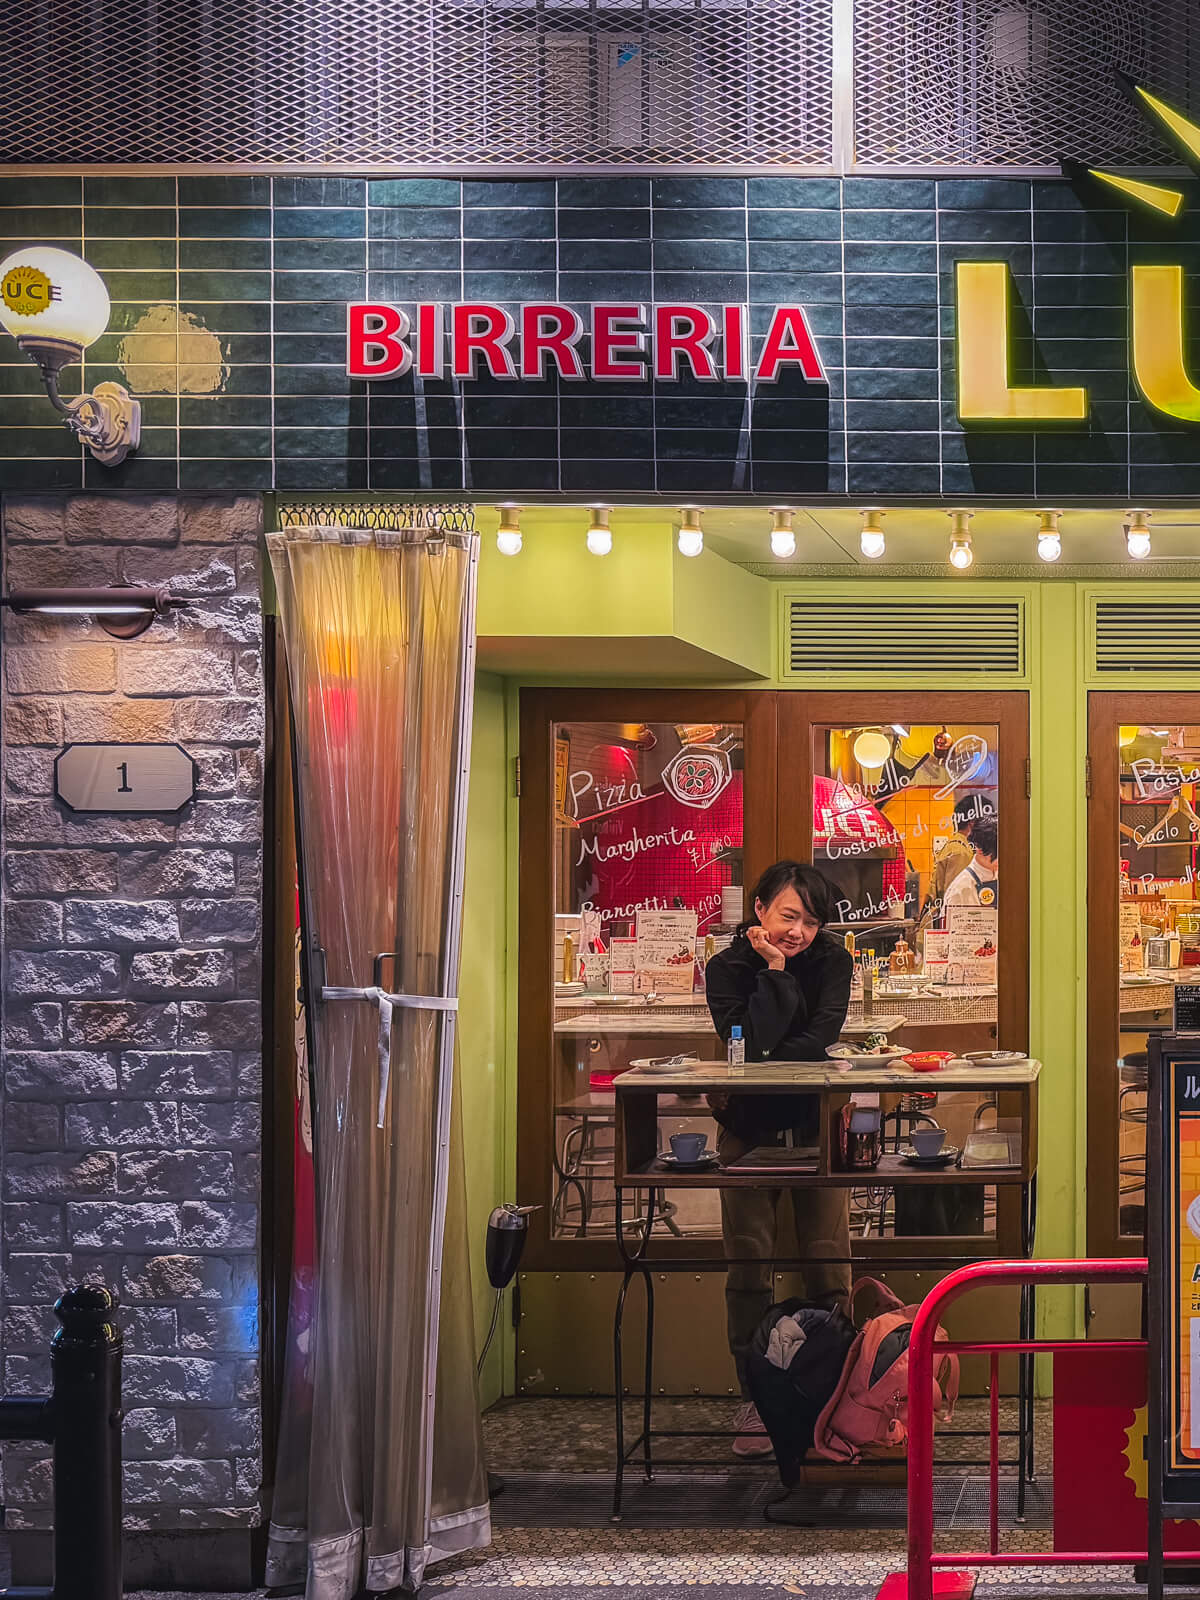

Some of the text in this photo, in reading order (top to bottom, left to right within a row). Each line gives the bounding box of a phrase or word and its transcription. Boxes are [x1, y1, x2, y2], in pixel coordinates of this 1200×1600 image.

[0, 282, 62, 301] UCE
[347, 303, 828, 381] BIRRERIA
[116, 761, 134, 793] 1
[569, 770, 646, 818] Pizza
[831, 759, 912, 805] Agnello
[575, 827, 697, 867] Margherita
[826, 828, 907, 860] Costolette
[1188, 821, 1200, 833] e
[835, 884, 917, 924] Porchetta
